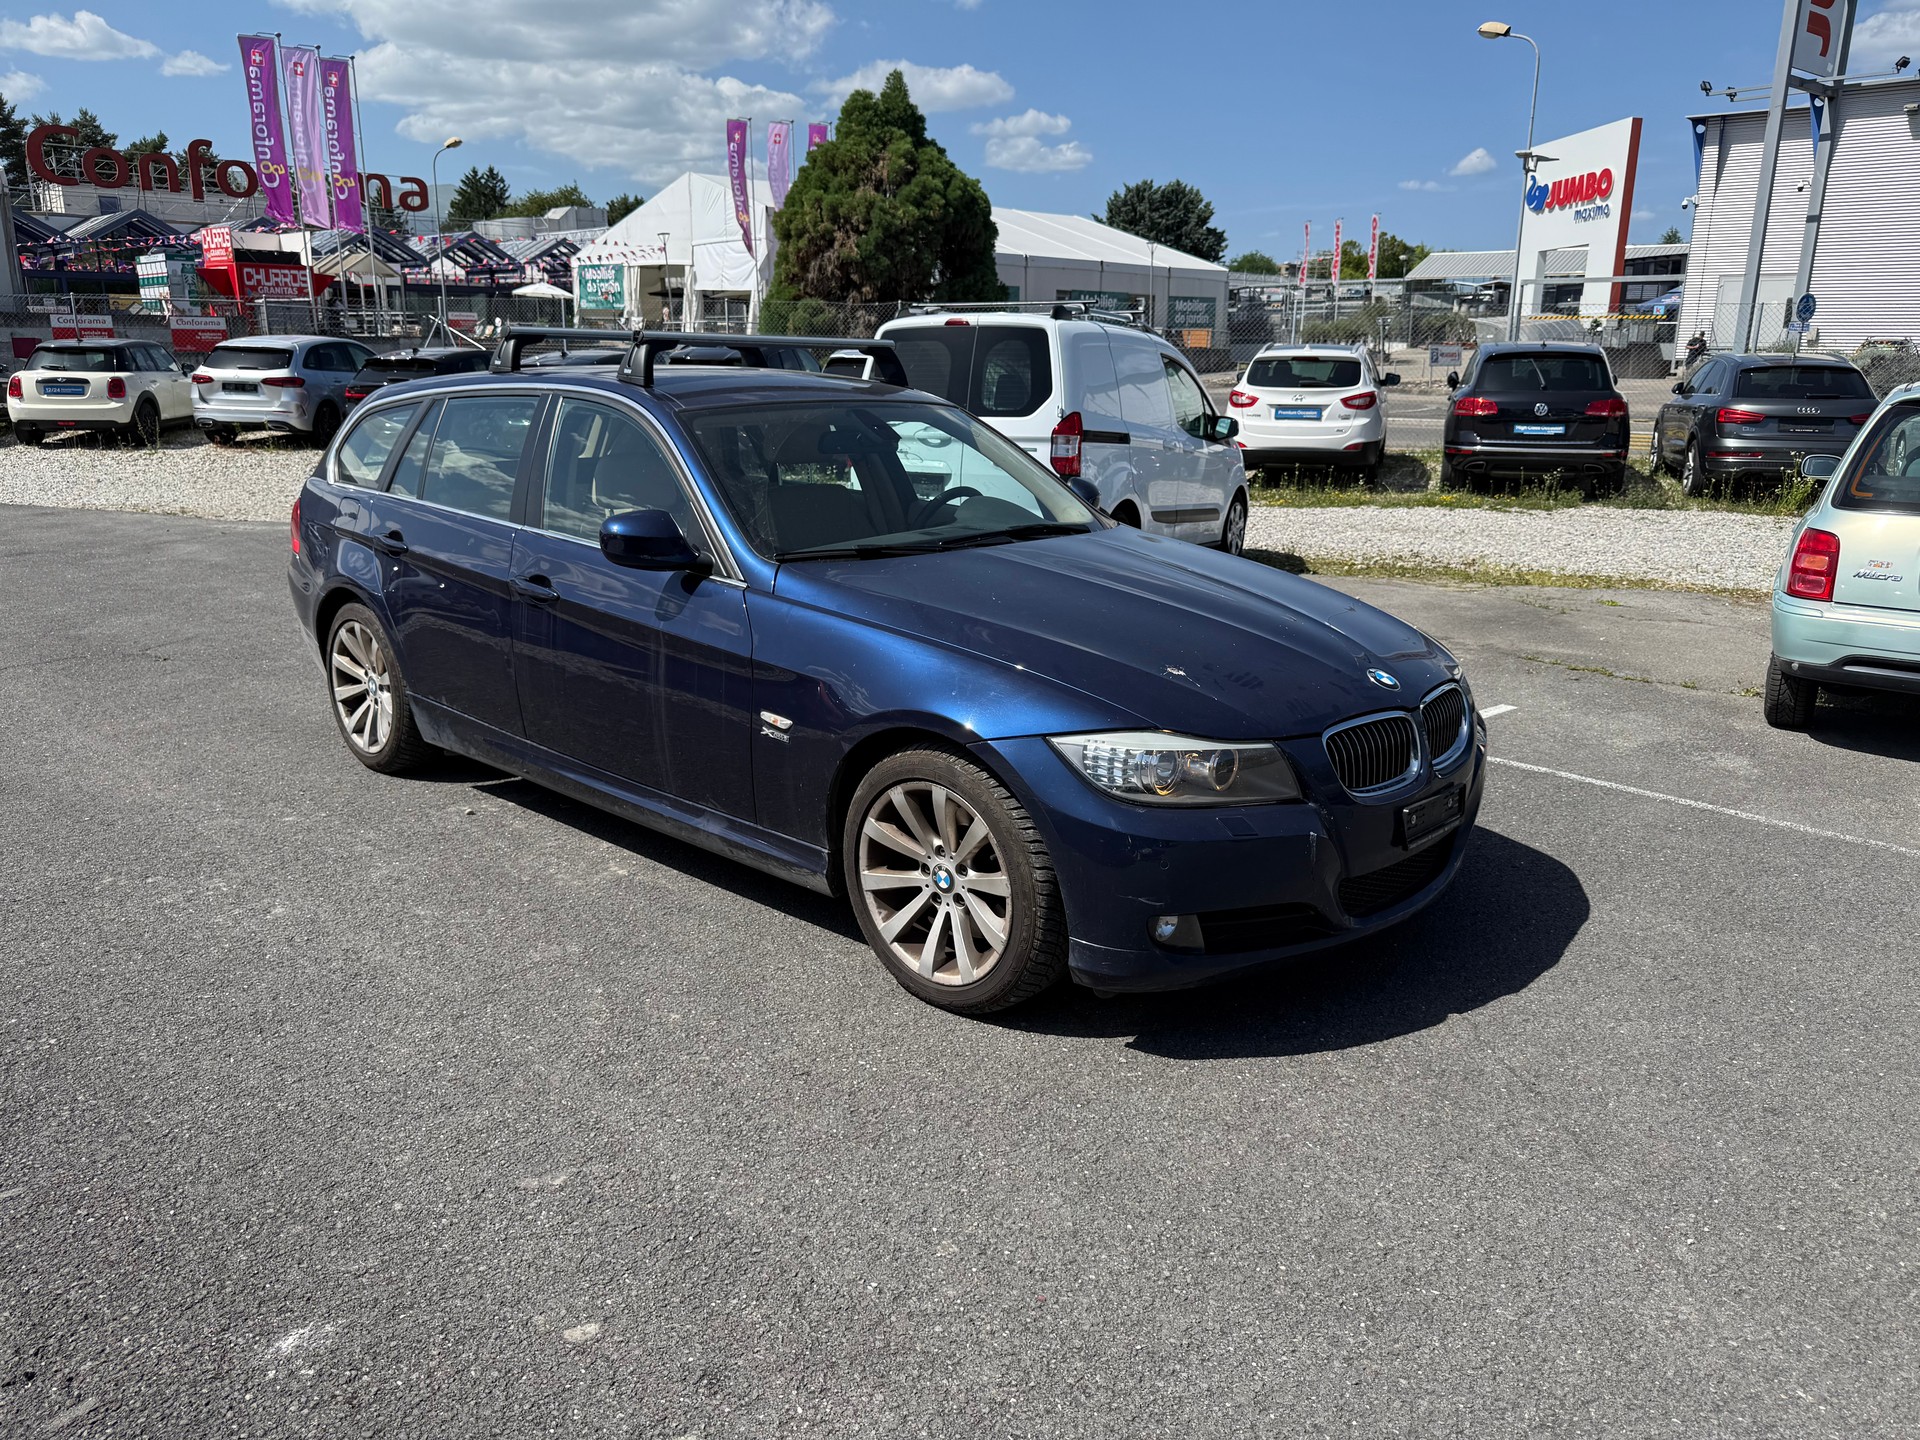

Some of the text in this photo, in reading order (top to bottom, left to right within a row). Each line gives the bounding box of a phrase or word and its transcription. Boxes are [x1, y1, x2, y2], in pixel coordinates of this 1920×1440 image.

[1545, 168, 1612, 209] JUMBO
[1574, 204, 1610, 220] maximo
[243, 267, 308, 287] CHURROS
[257, 286, 298, 295] GRANITAS
[57, 316, 107, 325] Conorama
[176, 318, 221, 326] Conforama
[1853, 569, 1903, 582] Micra
